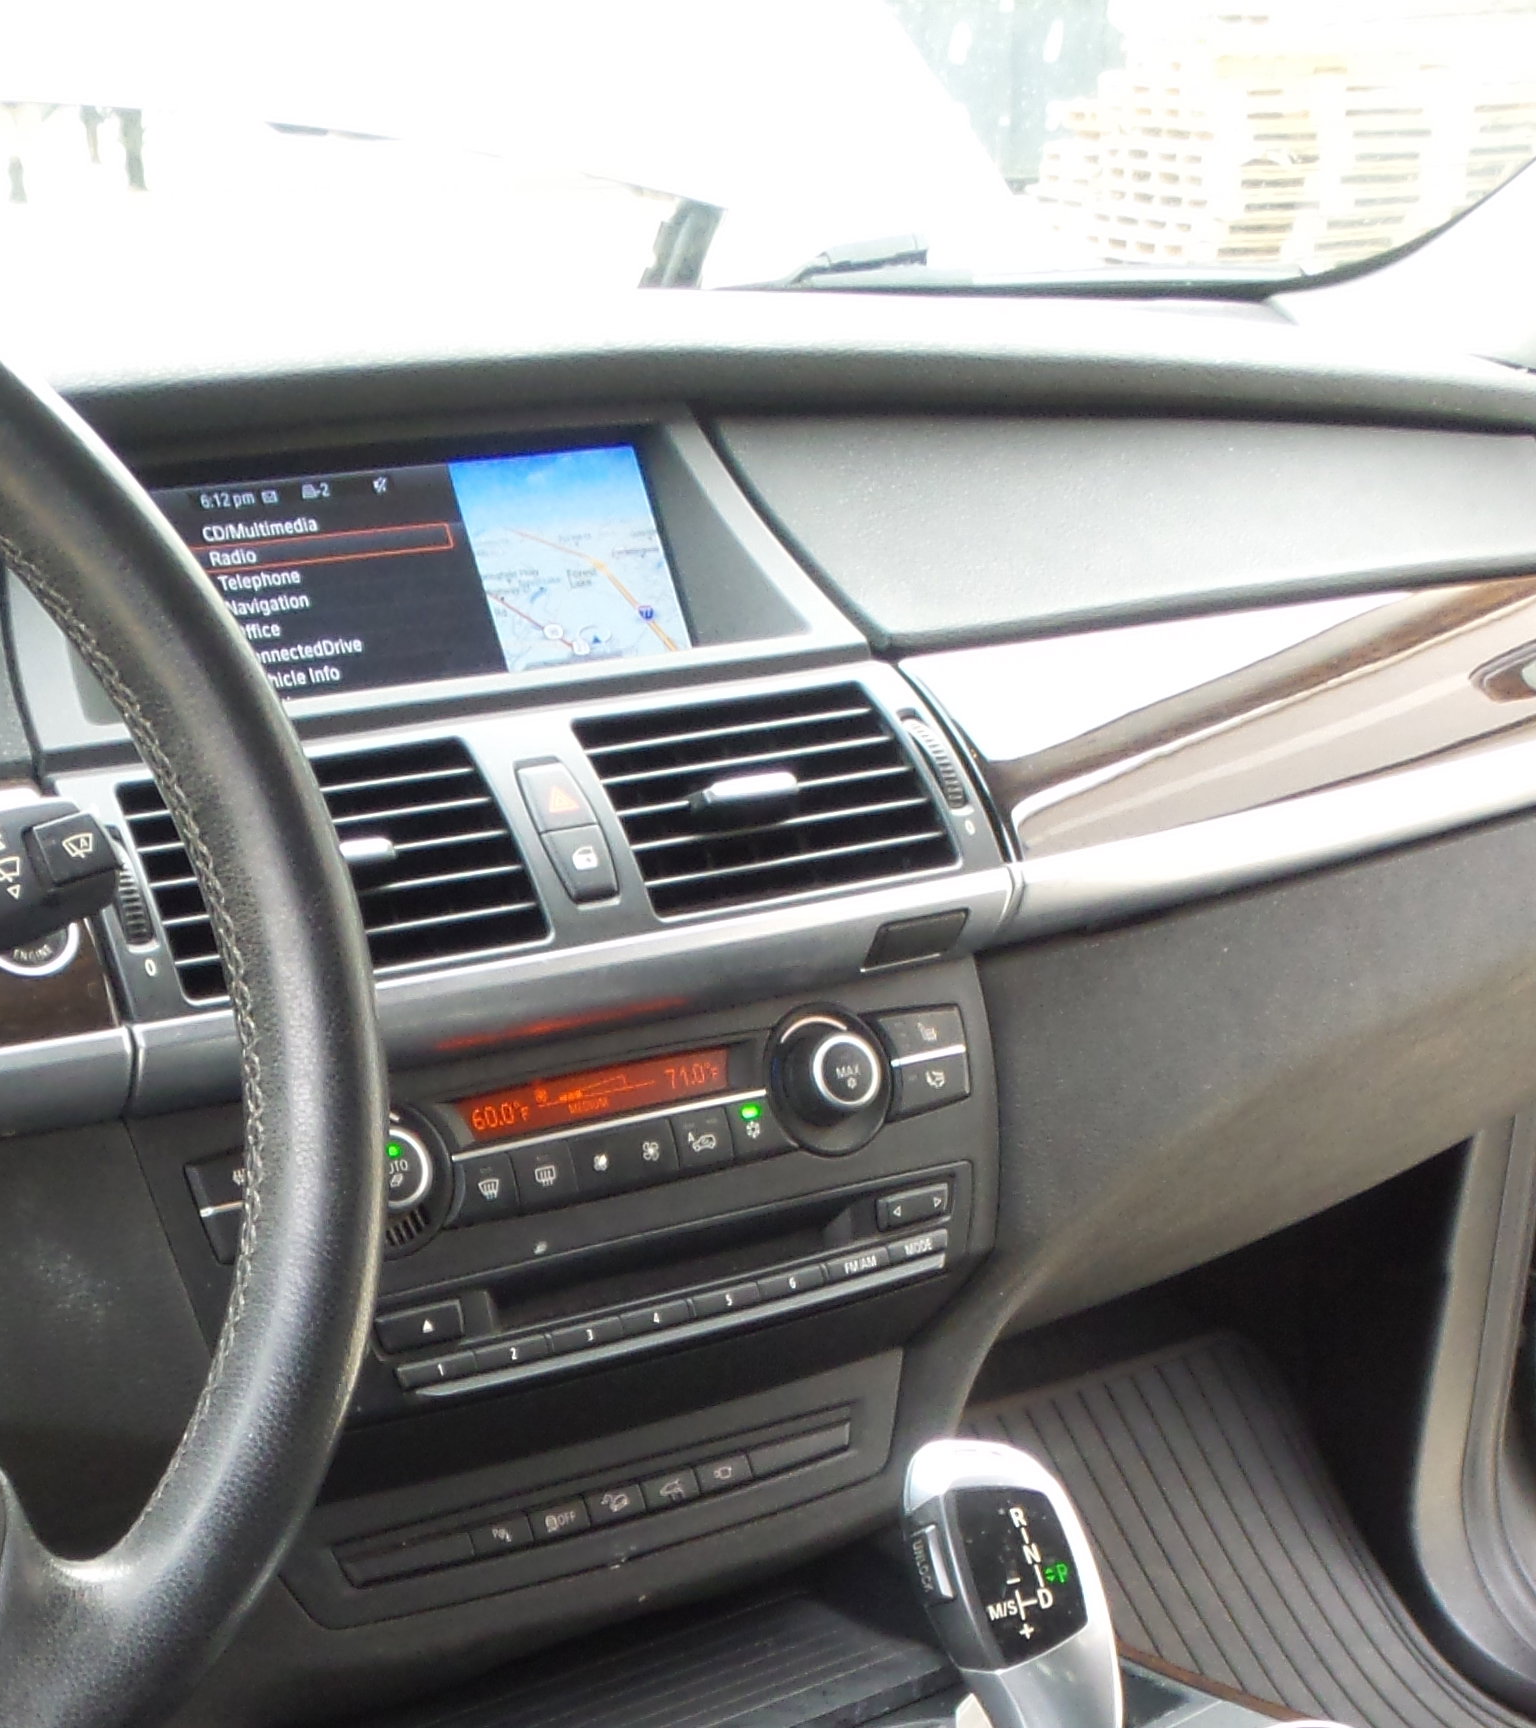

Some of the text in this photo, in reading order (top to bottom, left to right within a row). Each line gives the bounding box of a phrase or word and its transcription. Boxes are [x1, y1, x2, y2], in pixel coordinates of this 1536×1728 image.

[200, 491, 255, 510] 6:12 pm
[202, 516, 319, 543] CD/Multimedia
[208, 550, 257, 567] Radio
[218, 569, 301, 592] Telephone
[224, 593, 311, 617] Navigation
[240, 622, 282, 641] ffice
[309, 664, 341, 684] Info
[835, 1064, 862, 1079] MAX
[1009, 1506, 1028, 1529] R
[1022, 1542, 1042, 1566] N
[912, 1539, 934, 1593] UNLOCK
[1053, 1562, 1069, 1583] P
[1036, 1587, 1054, 1610] D
[986, 1600, 1019, 1622] M/S
